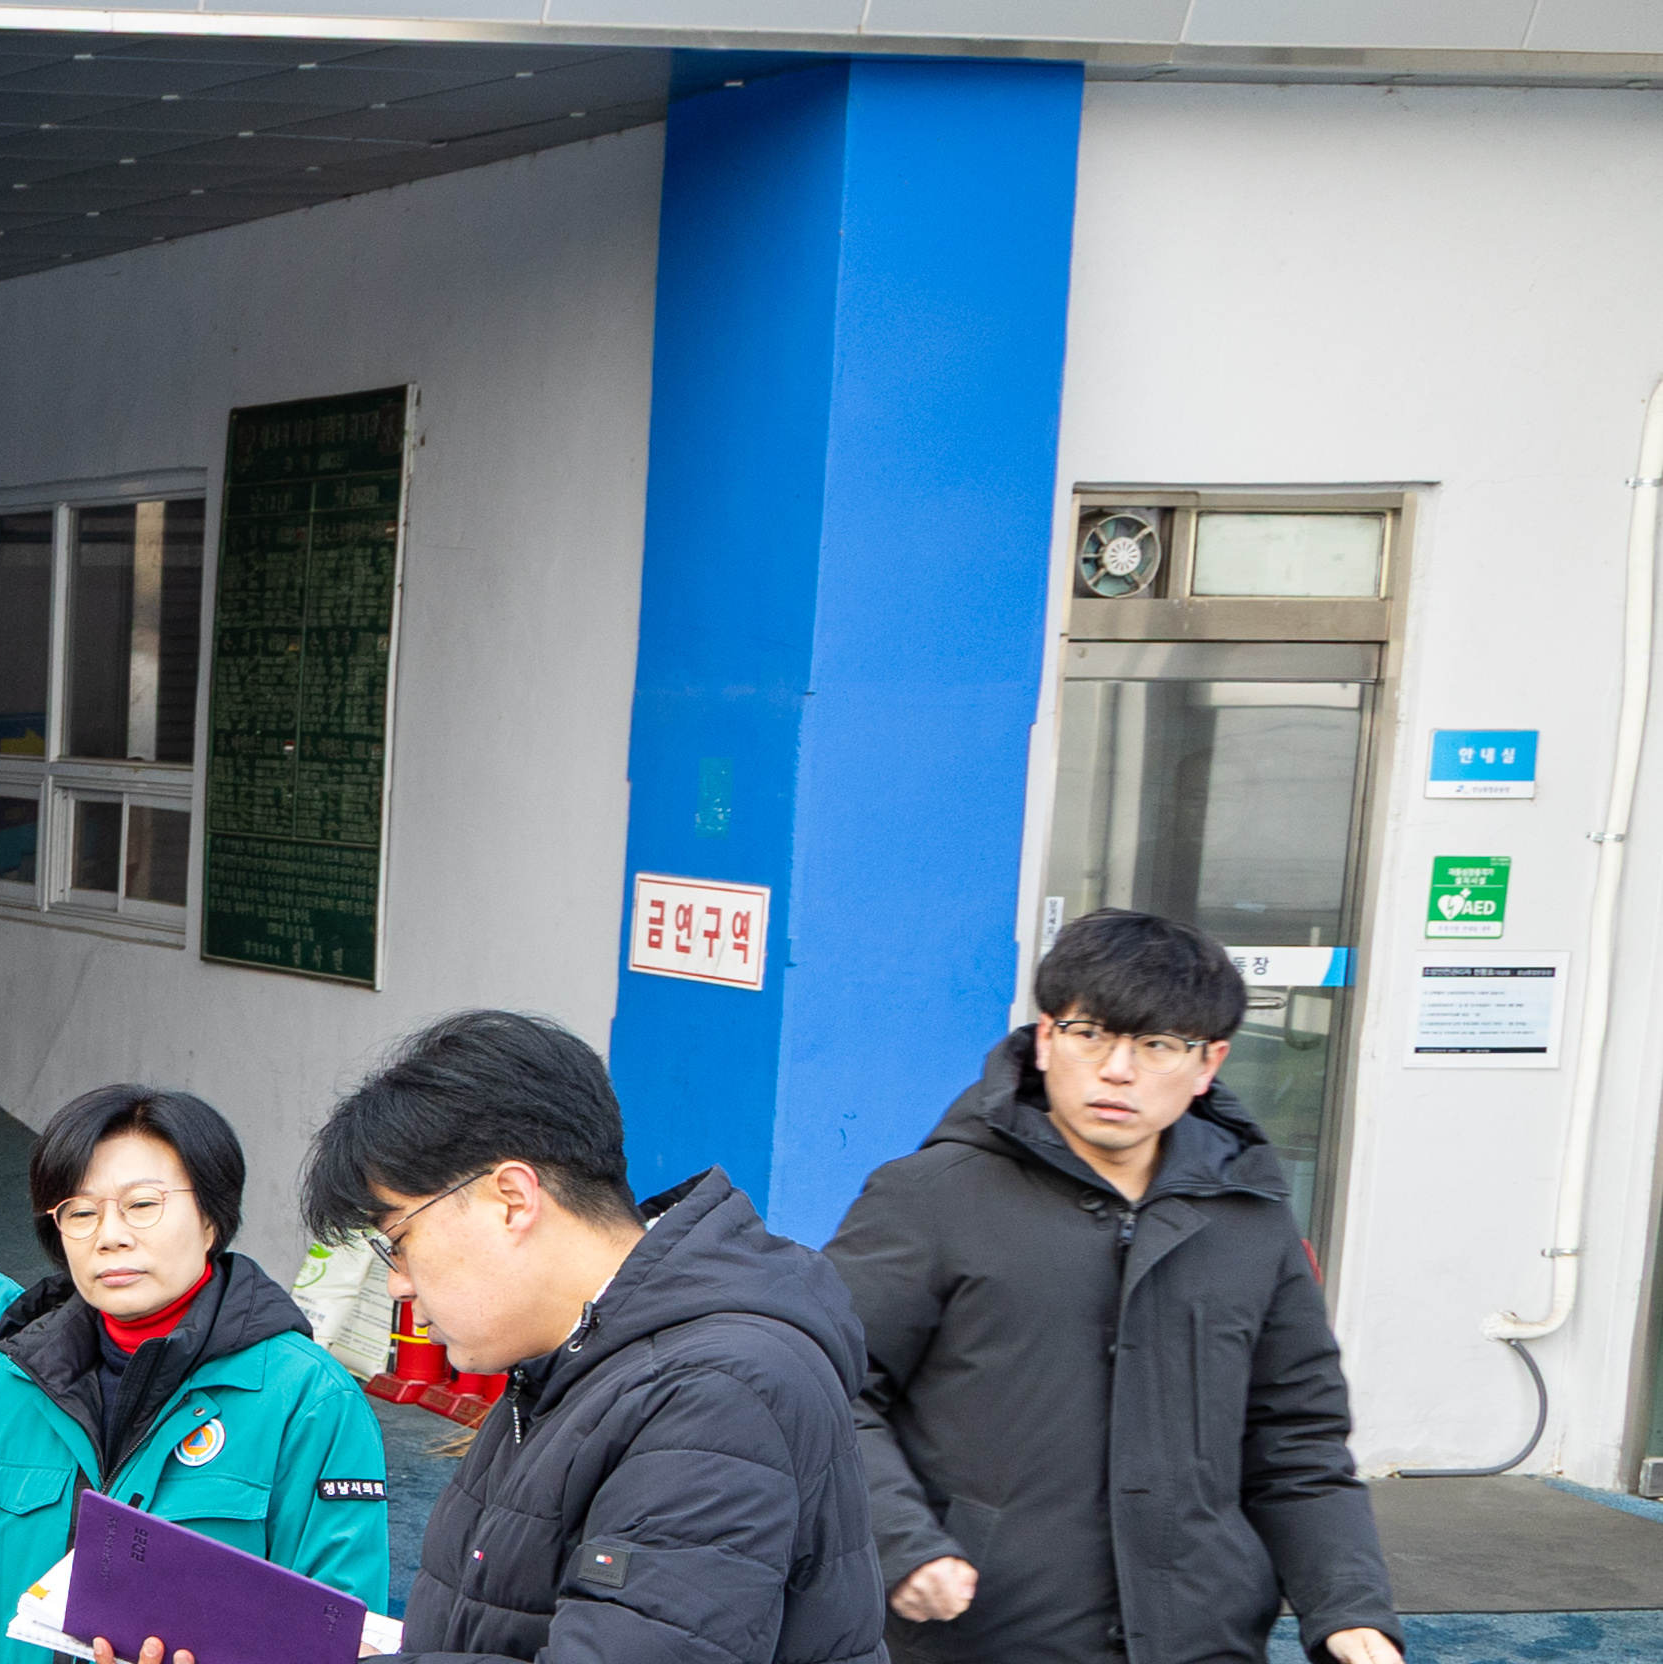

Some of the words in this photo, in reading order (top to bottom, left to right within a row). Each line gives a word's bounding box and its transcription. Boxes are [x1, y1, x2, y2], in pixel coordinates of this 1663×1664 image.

[1458, 747, 1516, 764] 안내실
[1461, 900, 1497, 915] AED
[647, 899, 751, 964] 금연구역
[323, 1481, 385, 1496] 성남시의회
[130, 1527, 149, 1564] 2026
